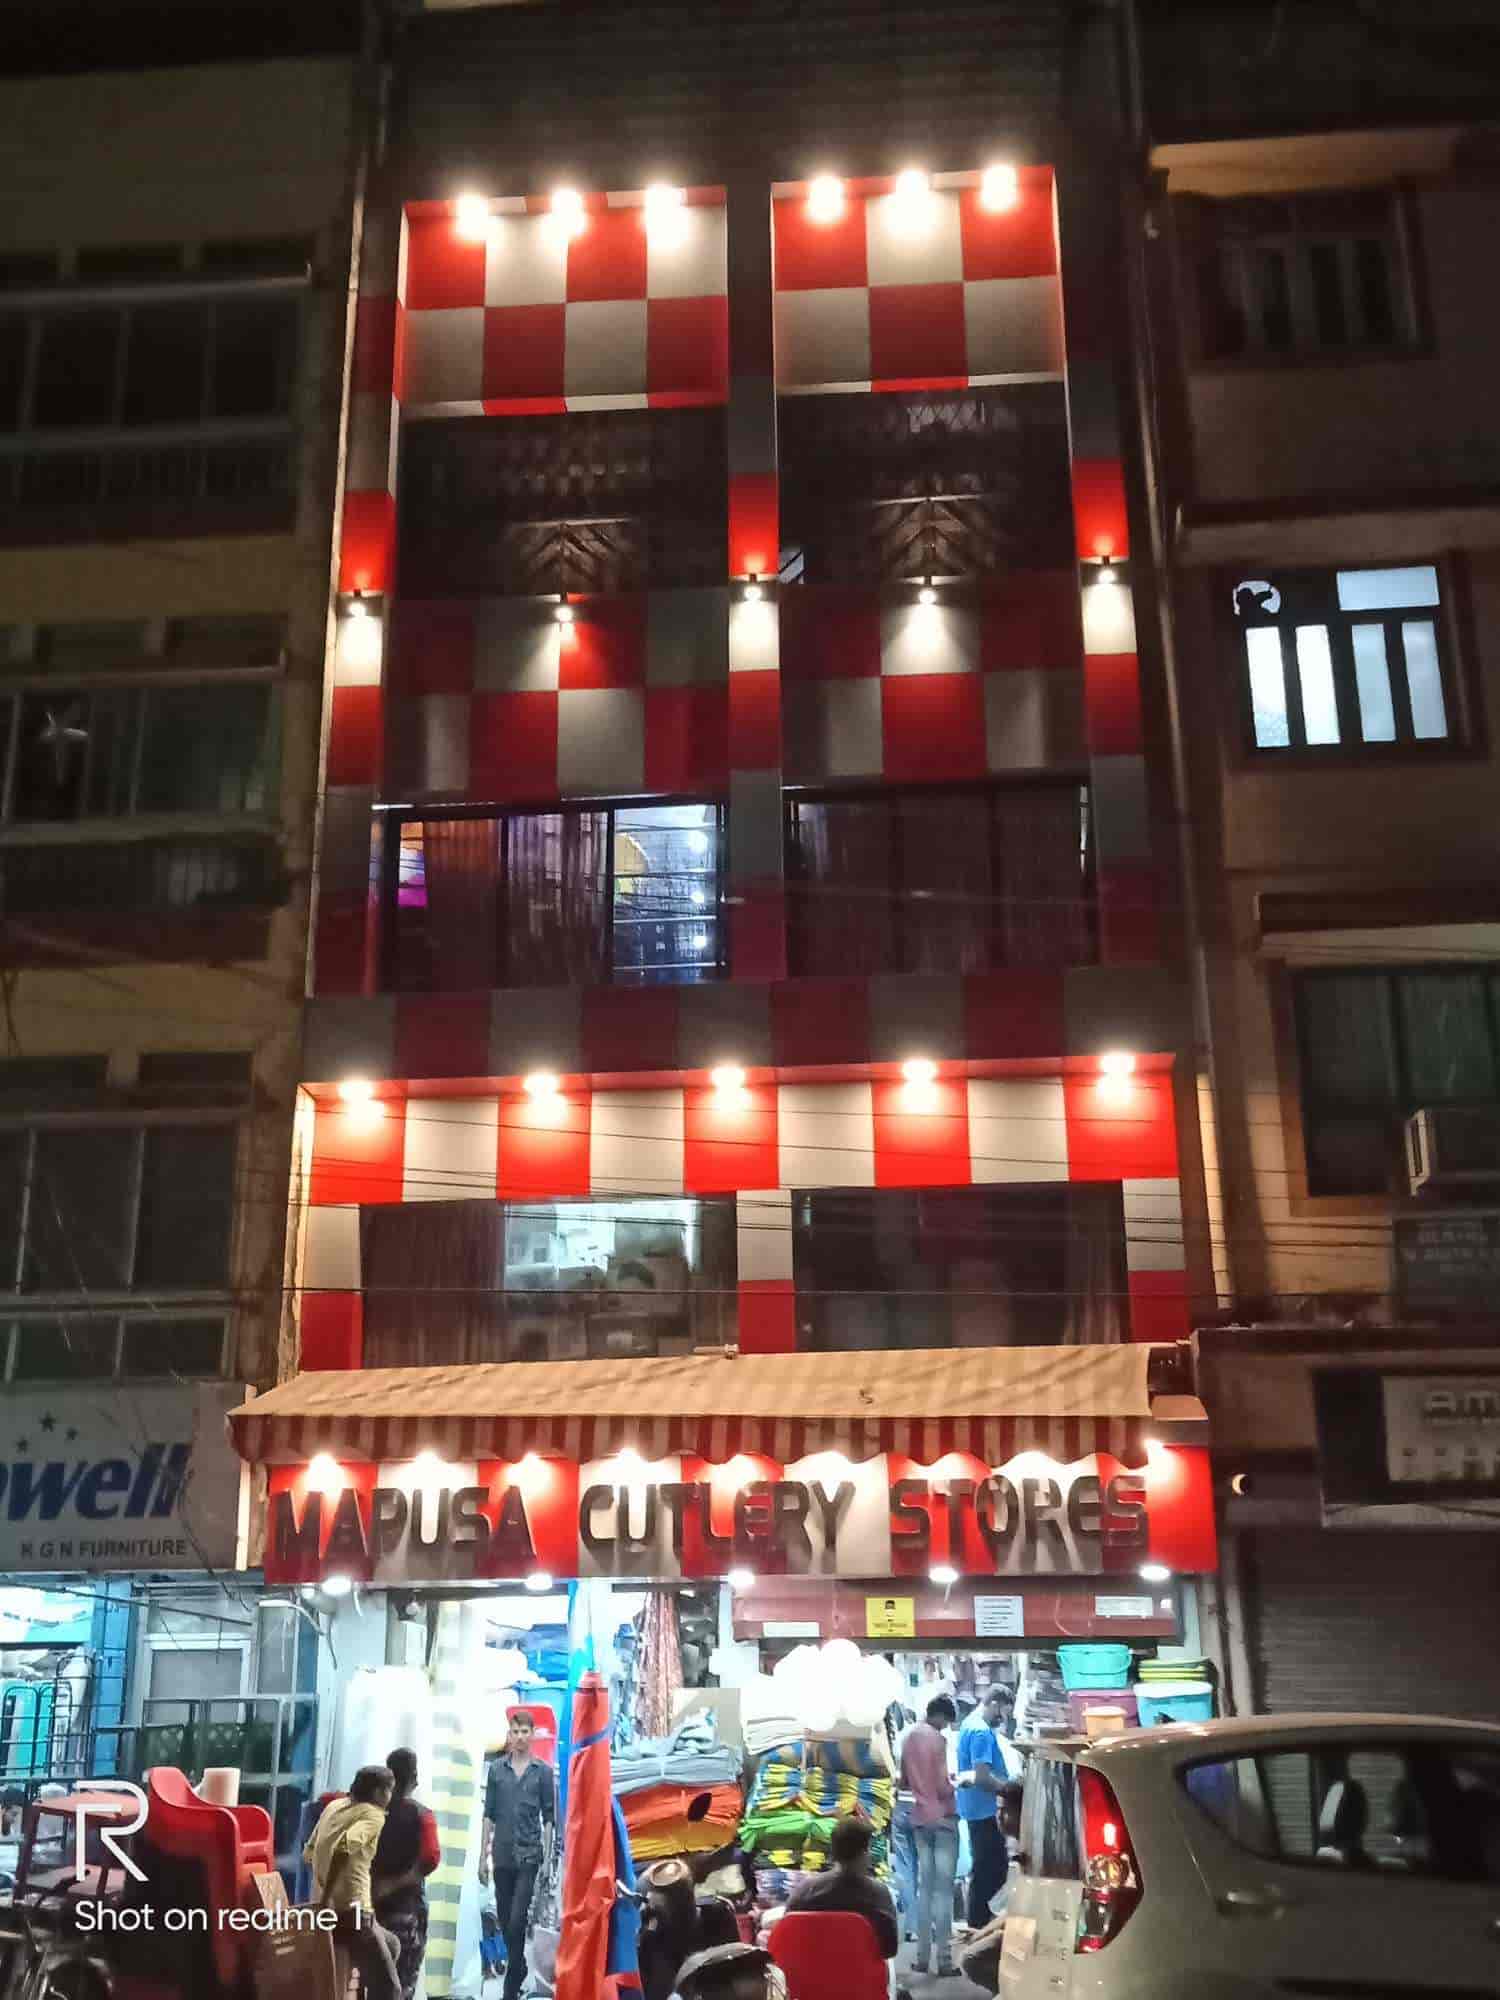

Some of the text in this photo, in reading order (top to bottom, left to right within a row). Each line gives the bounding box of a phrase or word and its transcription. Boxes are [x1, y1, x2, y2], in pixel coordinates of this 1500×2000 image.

[0, 1443, 193, 1521] well
[275, 1475, 1147, 1556] MAPUSA CUTLERY STORES
[79, 1538, 187, 1557] FURNITURE
